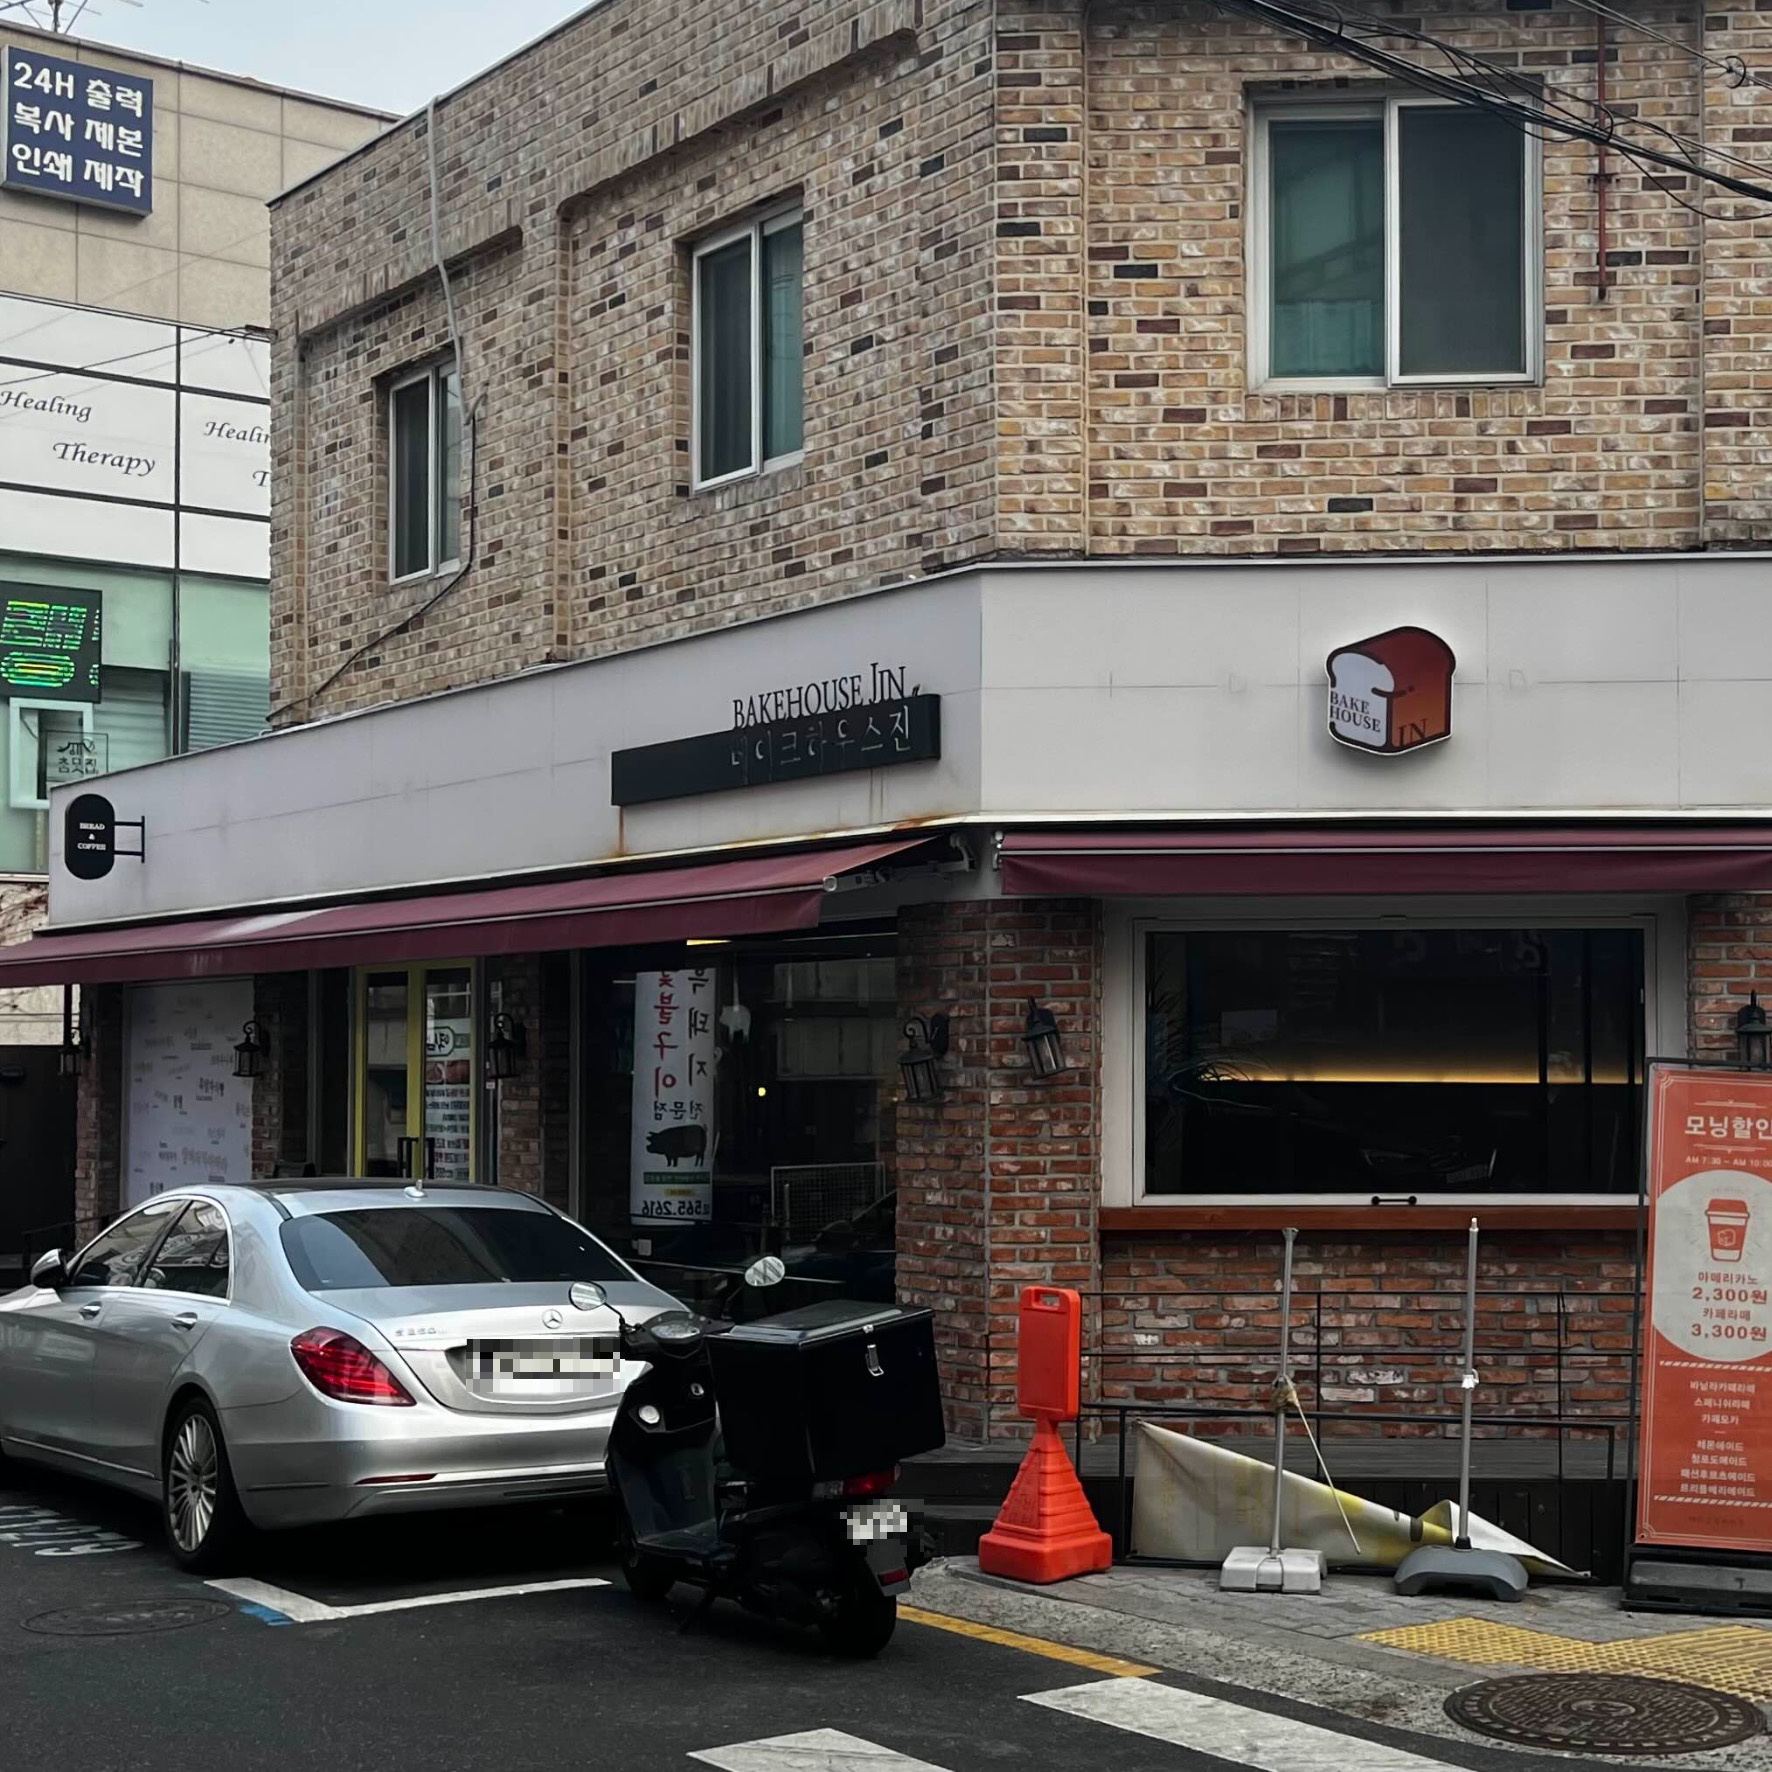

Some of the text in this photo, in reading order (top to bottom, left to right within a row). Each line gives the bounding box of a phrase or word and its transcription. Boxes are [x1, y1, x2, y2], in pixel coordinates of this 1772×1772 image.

[13, 62, 143, 118] 24H 출력
[14, 102, 143, 157] 복사 제본
[12, 143, 145, 198] 인쇄 제작
[0, 390, 92, 423] Healing
[52, 442, 156, 477] Therapy
[732, 675, 864, 729] BAKEHOUSE
[1330, 690, 1370, 715] BAKE
[1329, 705, 1381, 733] HOUSE
[1685, 1154, 1699, 1164] AM
[1732, 1157, 1747, 1167] AM
[1698, 1271, 1758, 1285] 아메리카노
[1702, 1307, 1751, 1321] 카페라떼
